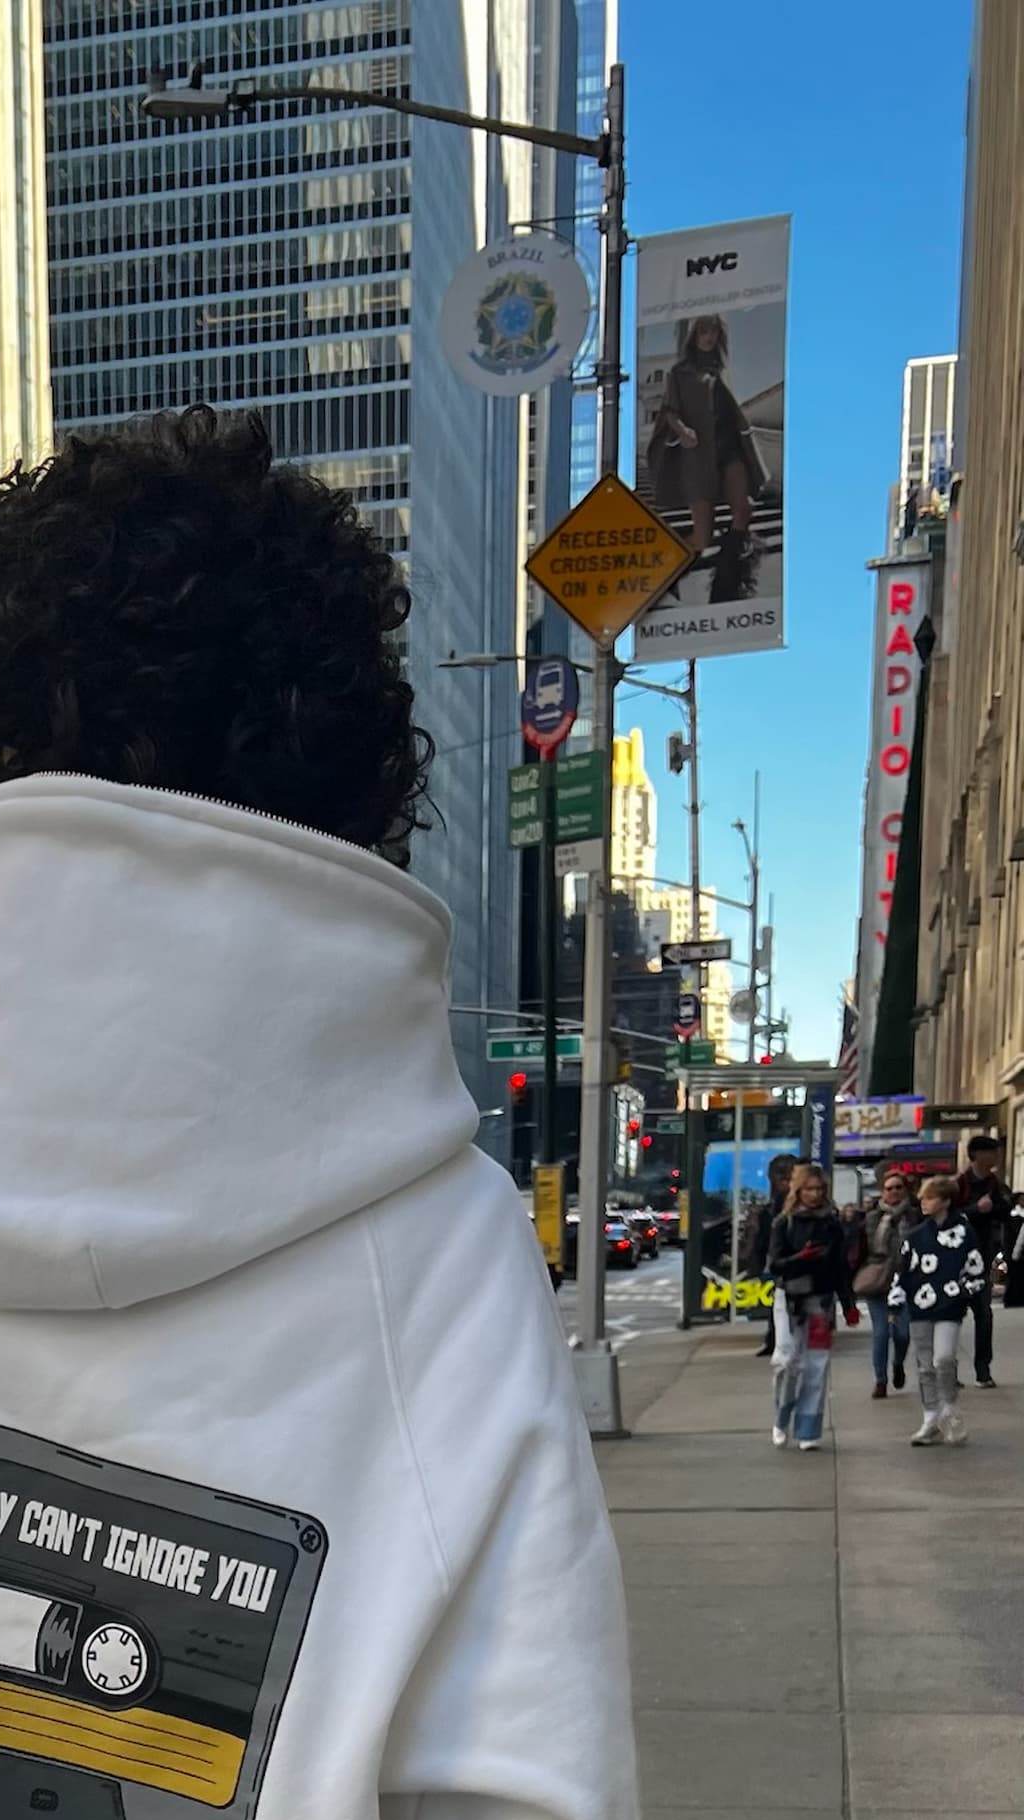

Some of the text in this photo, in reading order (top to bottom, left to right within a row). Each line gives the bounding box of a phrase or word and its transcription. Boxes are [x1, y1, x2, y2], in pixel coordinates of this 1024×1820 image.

[487, 248, 545, 269] BRAZIL
[686, 252, 738, 278] NYC
[559, 528, 658, 549] RECESSED
[550, 552, 665, 574] CROSSWALK
[562, 575, 651, 598] ON 6 AVE
[640, 610, 777, 639] MICHAEL KORS
[880, 583, 916, 777] RADIO
[18, 1500, 103, 1561] CAN'T
[103, 1524, 210, 1594] IGNORE
[210, 1555, 276, 1613] YOU
